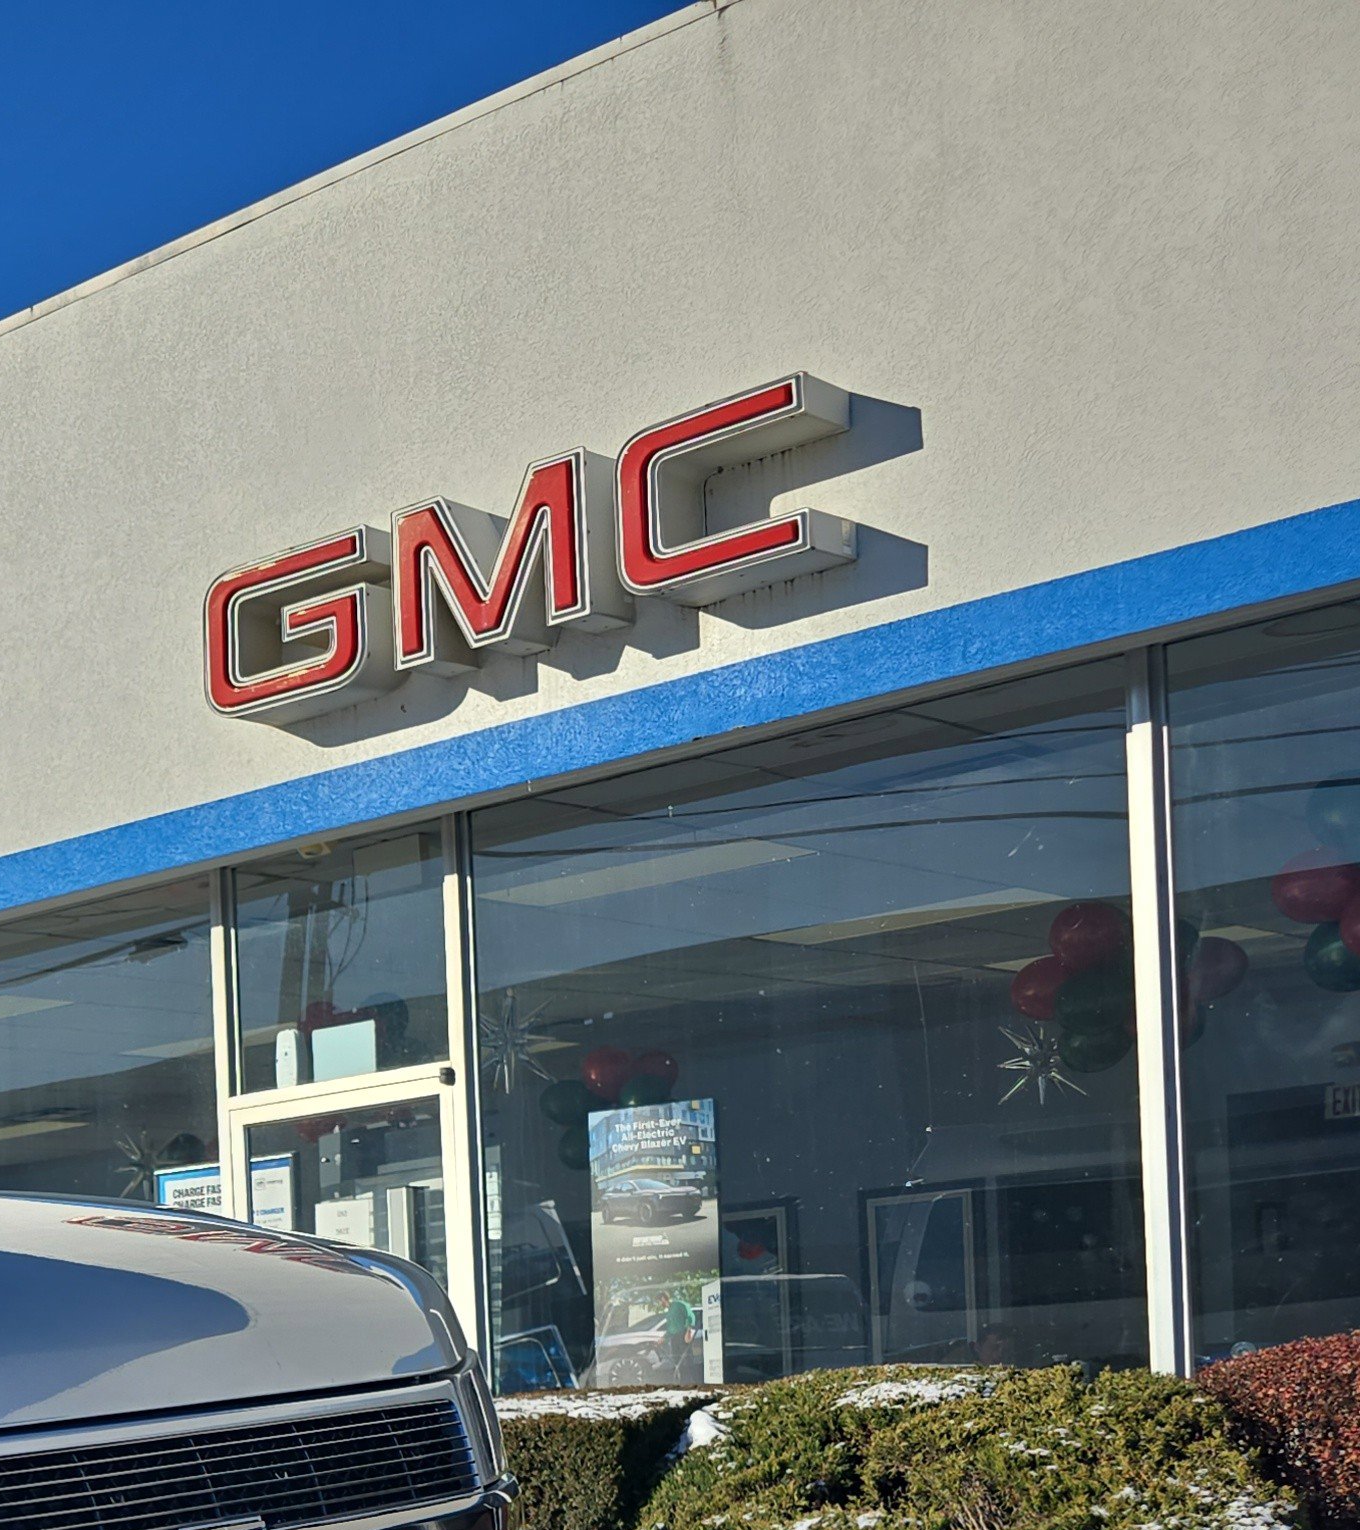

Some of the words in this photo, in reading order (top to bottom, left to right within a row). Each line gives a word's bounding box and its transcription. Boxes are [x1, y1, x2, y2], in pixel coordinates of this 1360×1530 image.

[204, 371, 811, 718] GMC
[1332, 1085, 1360, 1116] EXI
[615, 1124, 632, 1133] The
[633, 1118, 682, 1130] First-Ever
[621, 1128, 675, 1141] All-Electric
[612, 1142, 640, 1153] Chevy
[641, 1139, 672, 1149] Blazer
[673, 1136, 687, 1146] EV
[173, 1186, 205, 1199] CHARGE
[207, 1184, 222, 1195] FAS
[207, 1196, 222, 1206] FAS
